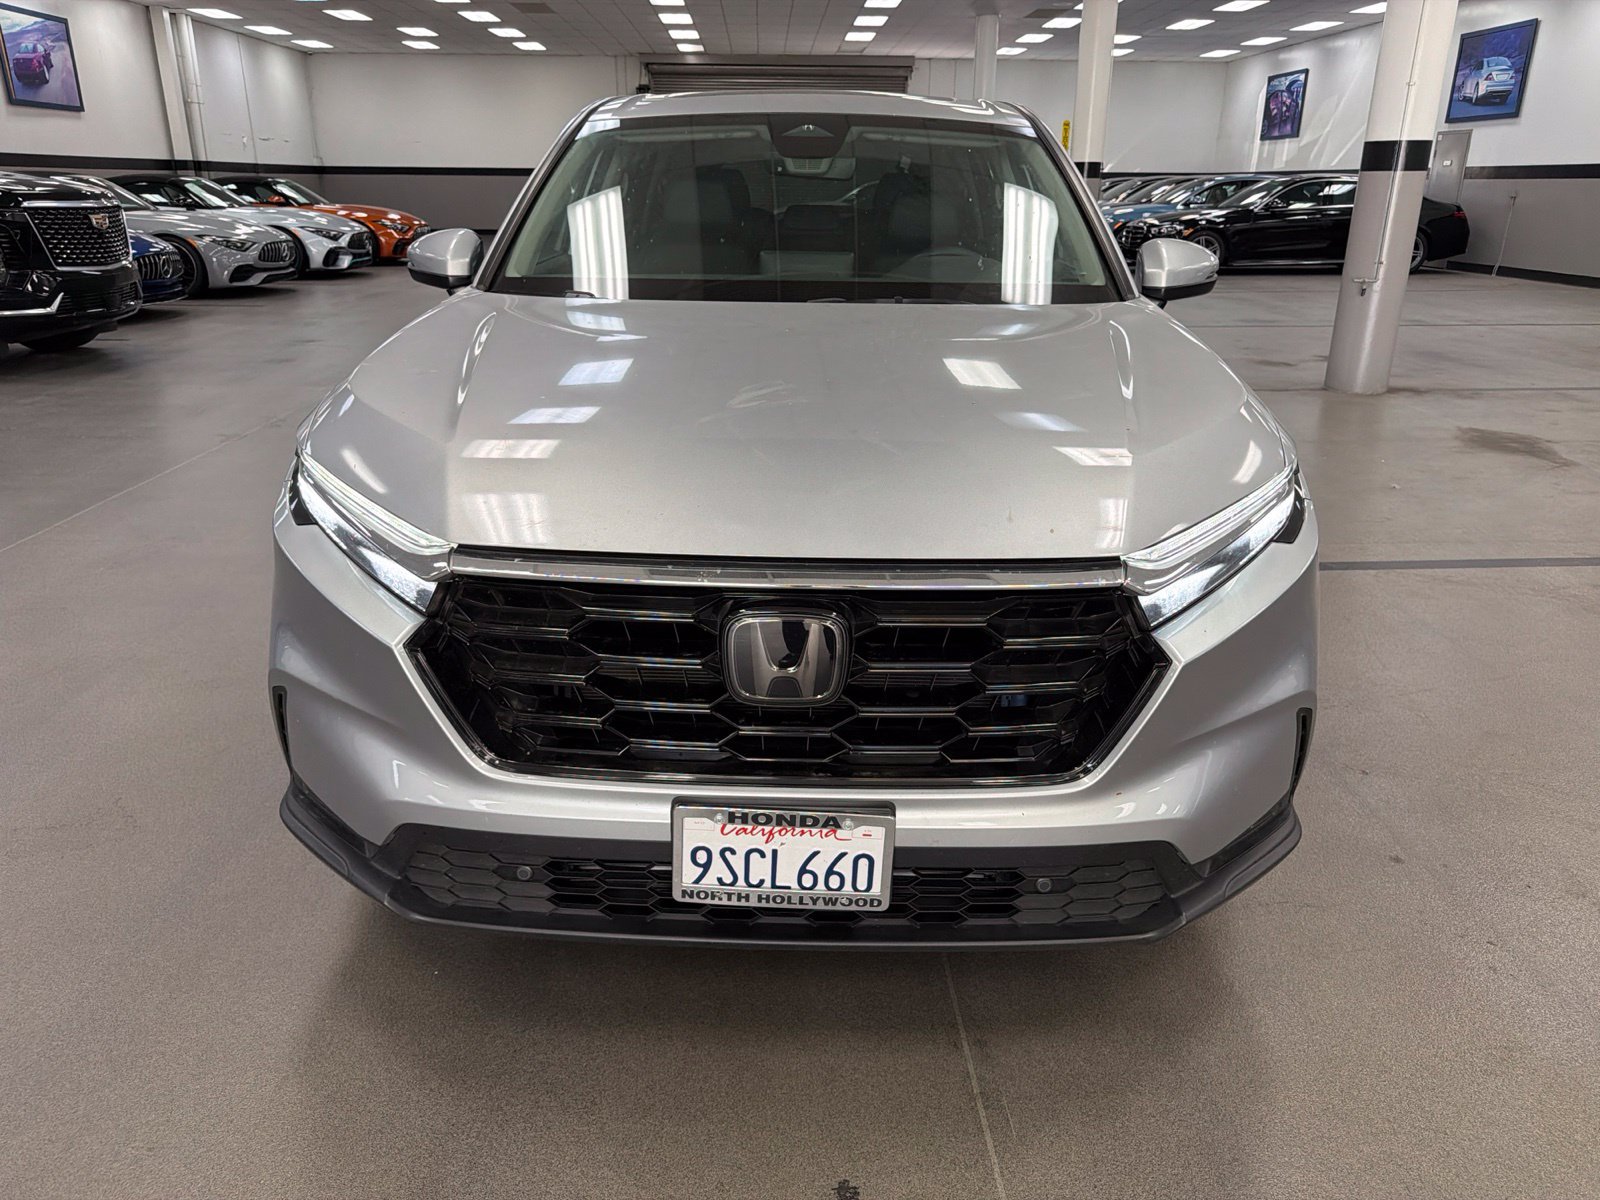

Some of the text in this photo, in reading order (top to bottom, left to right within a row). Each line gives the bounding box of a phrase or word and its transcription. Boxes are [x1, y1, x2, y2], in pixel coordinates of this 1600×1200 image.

[727, 811, 842, 829] HONDA
[690, 845, 875, 893] 9SCL660
[680, 888, 883, 908] NORTH HOLLYWOOD
